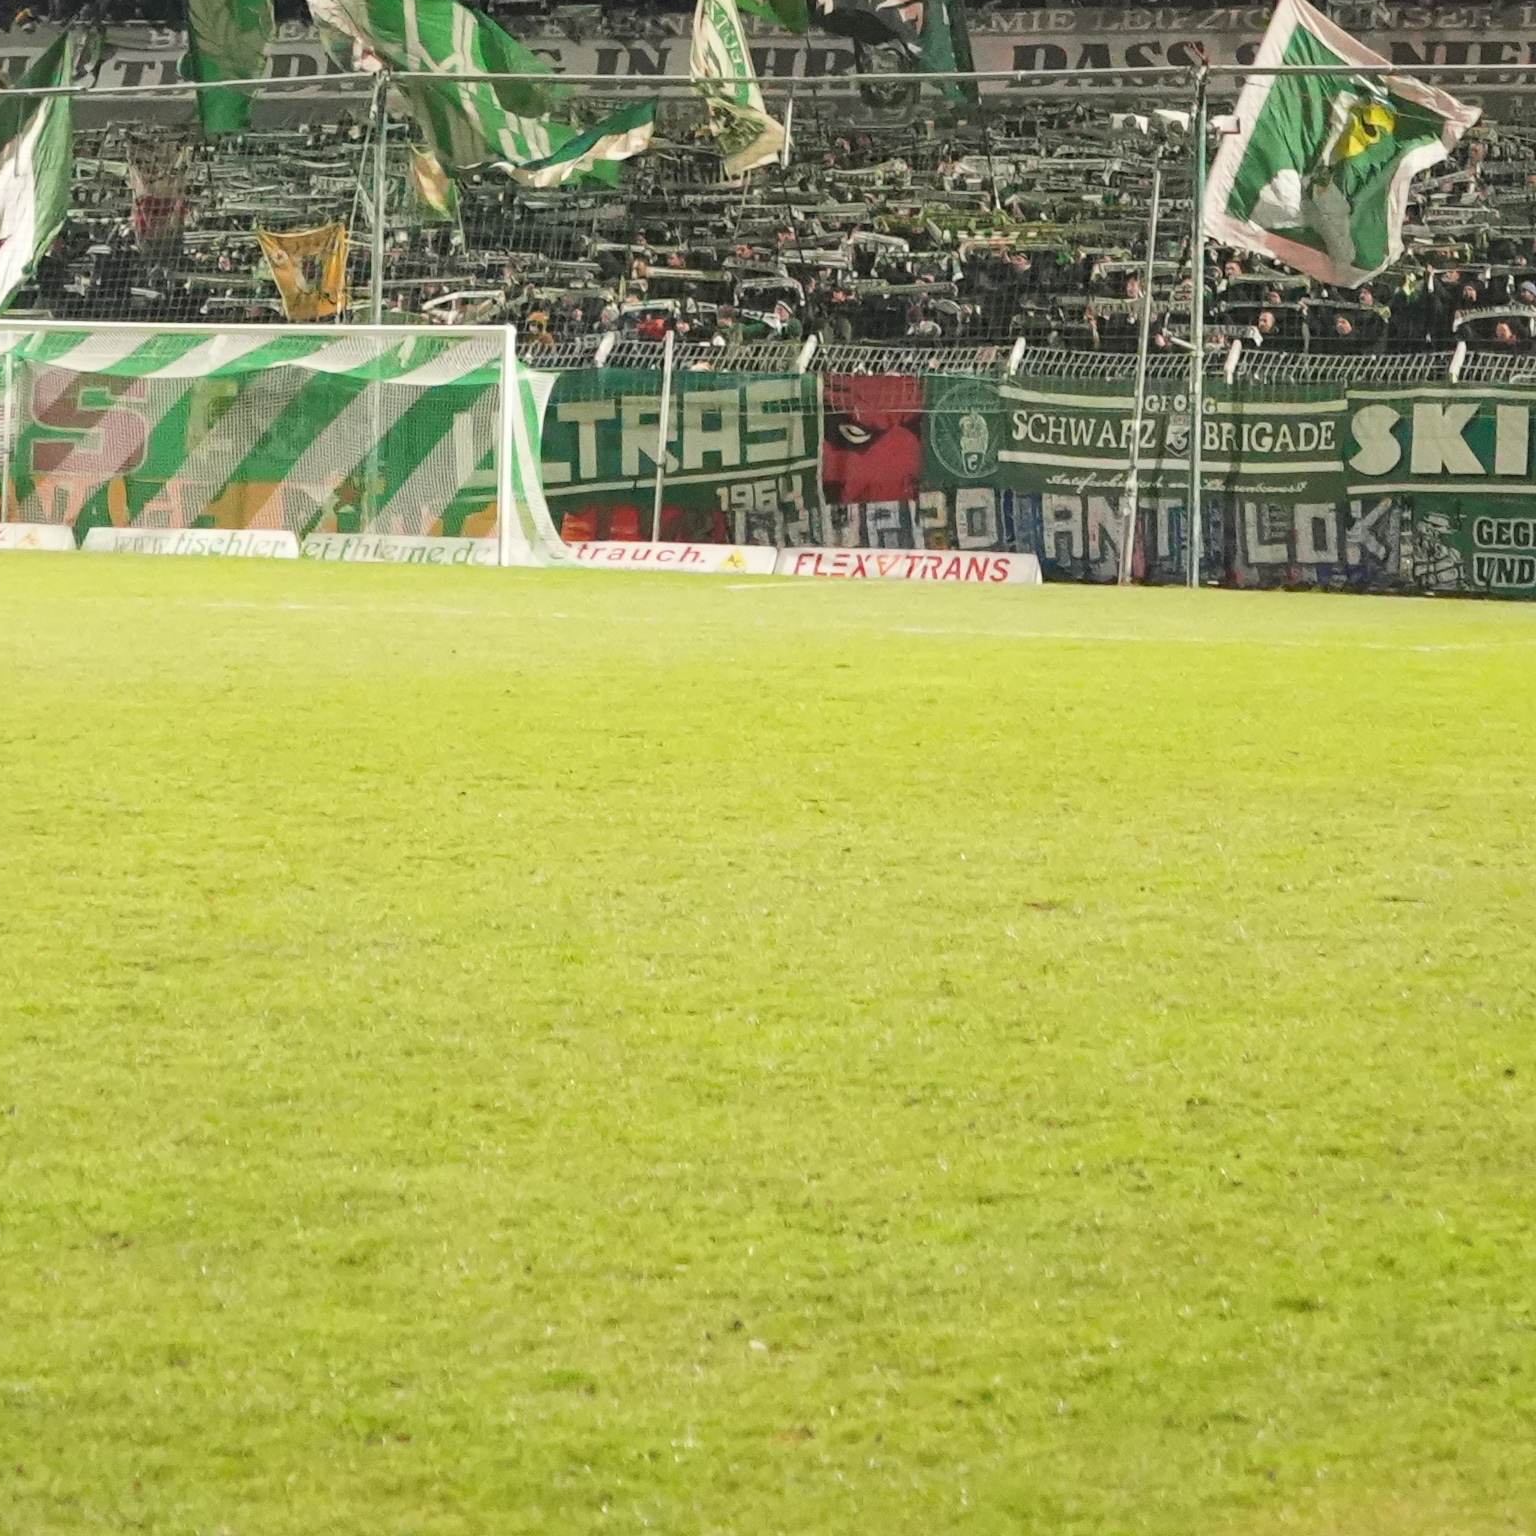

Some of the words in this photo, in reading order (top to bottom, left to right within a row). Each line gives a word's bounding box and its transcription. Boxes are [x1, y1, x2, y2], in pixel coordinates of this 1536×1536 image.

[1007, 41, 1206, 88] DASS
[1011, 409, 1156, 451] SCHWARZ
[1202, 420, 1336, 453] BRIGADE
[716, 474, 806, 513] 1964
